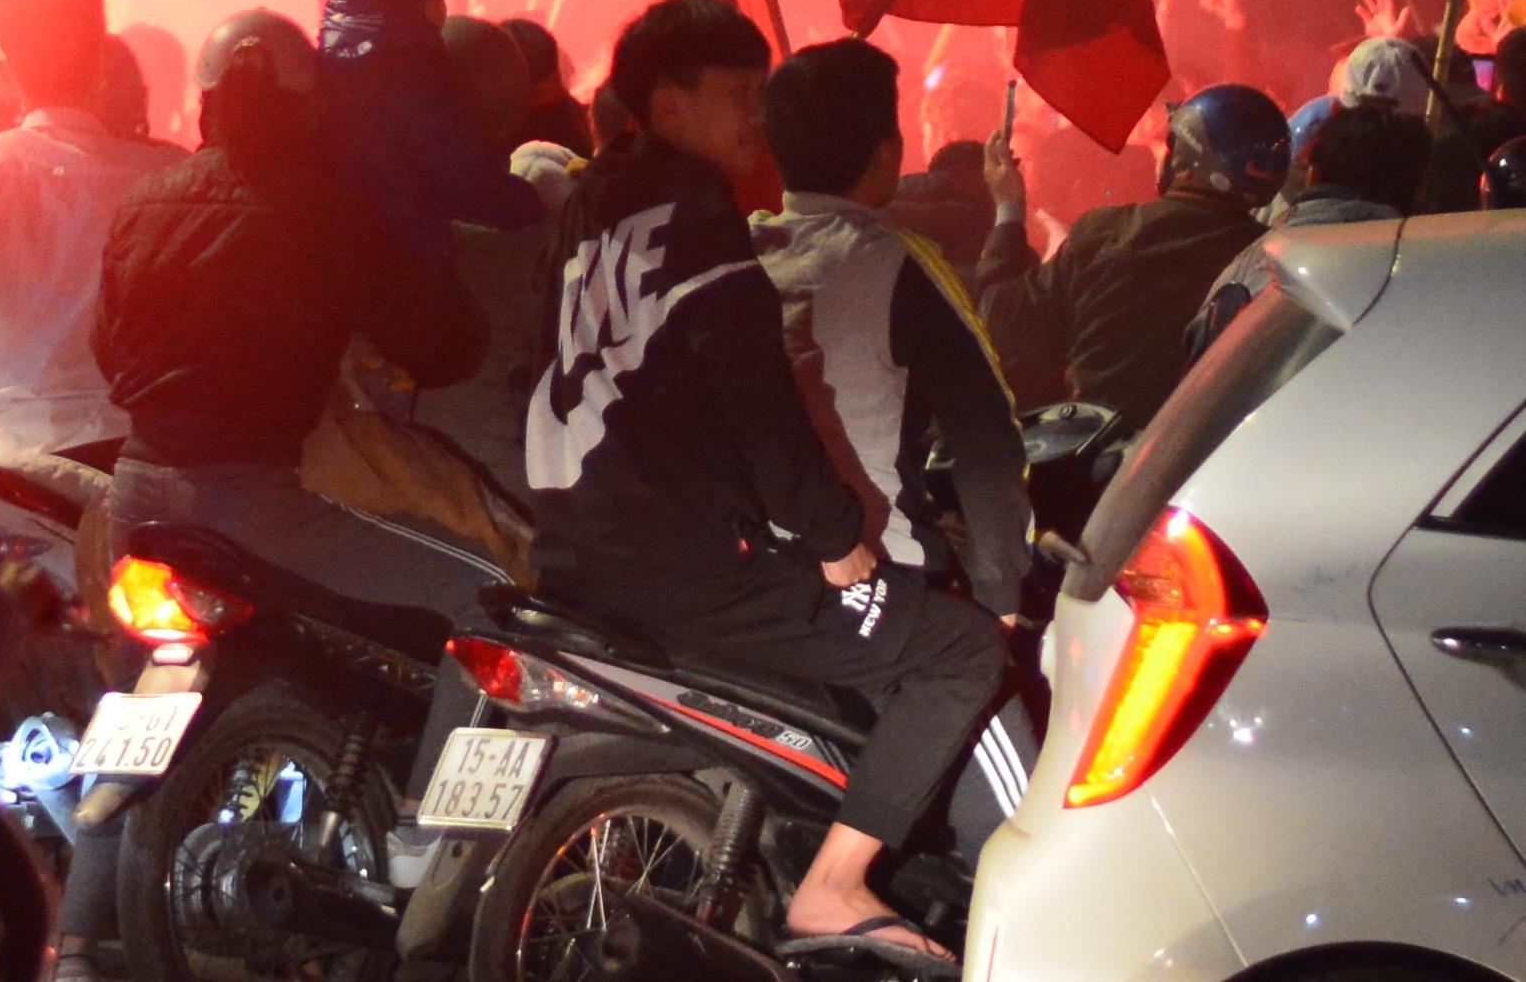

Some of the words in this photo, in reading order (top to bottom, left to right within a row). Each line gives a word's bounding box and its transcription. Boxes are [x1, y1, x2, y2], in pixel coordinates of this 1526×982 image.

[859, 603, 882, 637] NEW
[873, 578, 888, 603] YOR
[458, 738, 530, 777] 15-AA
[432, 779, 524, 820] 183.57
